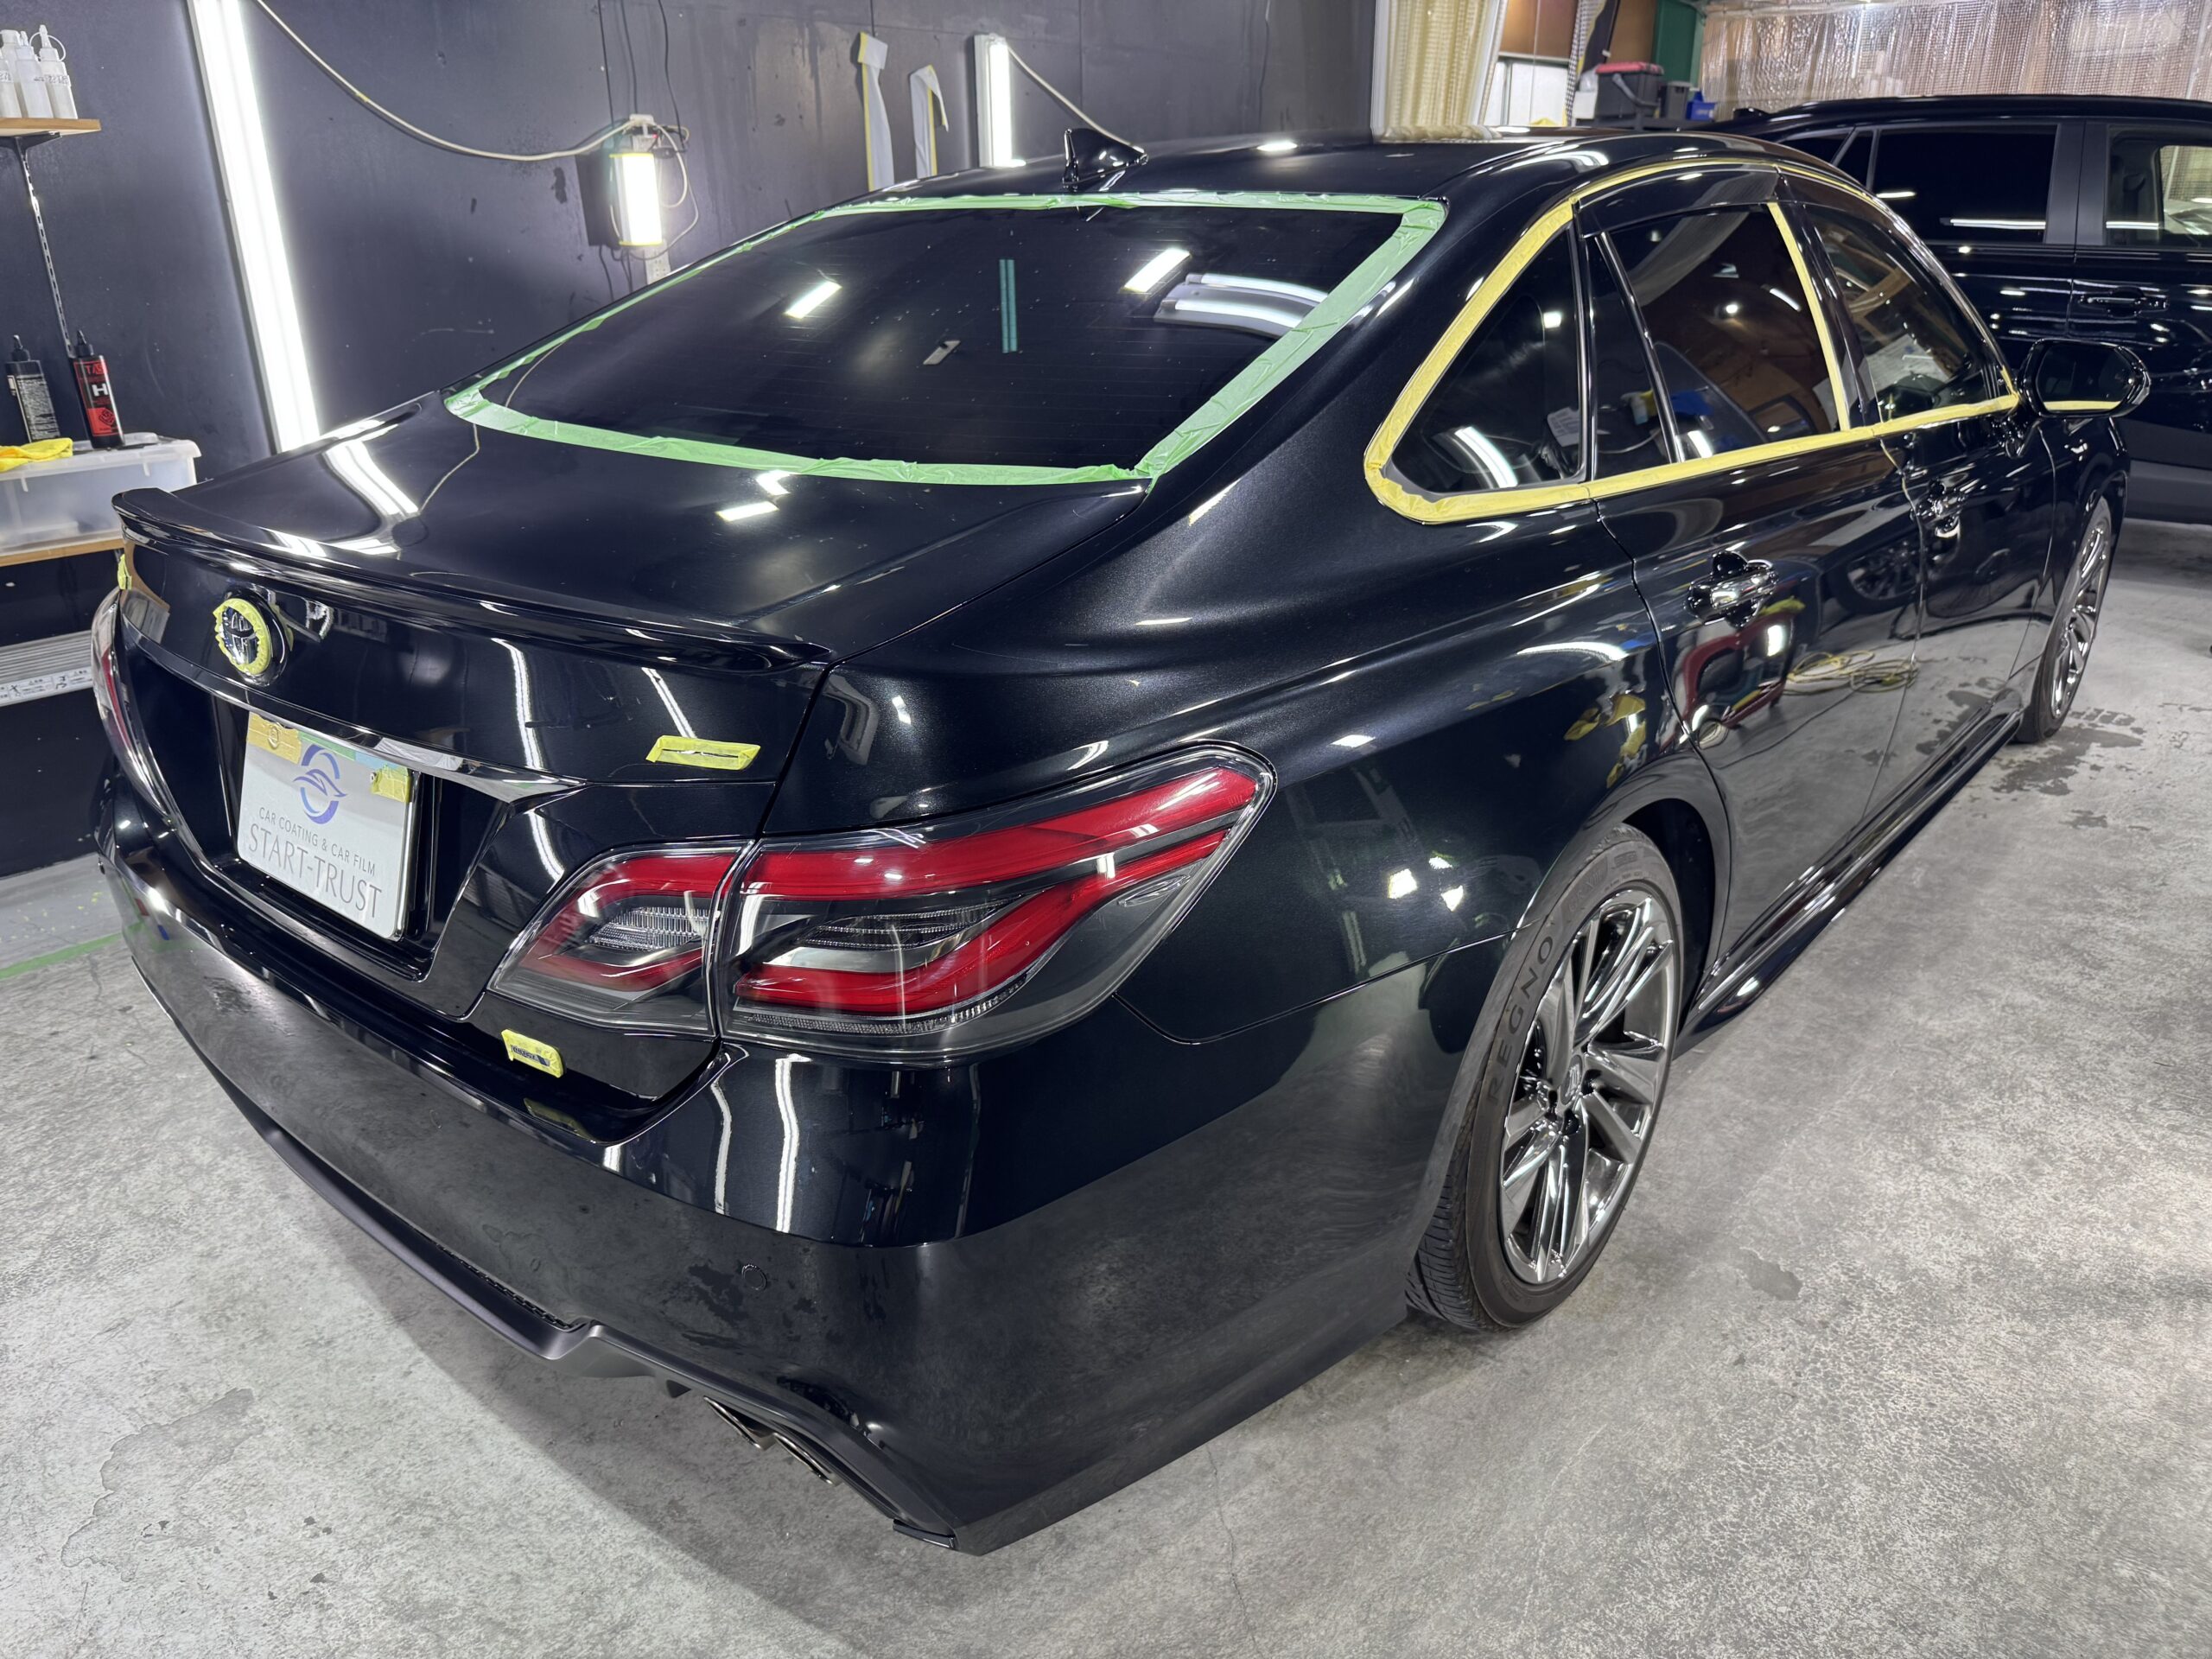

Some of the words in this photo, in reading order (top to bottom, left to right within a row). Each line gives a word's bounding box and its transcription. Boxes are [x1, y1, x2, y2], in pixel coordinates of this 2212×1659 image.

[248, 823, 382, 918] START-TRUST
[259, 807, 276, 824] CAR
[279, 817, 318, 847] COATING
[321, 838, 327, 851] &
[331, 843, 350, 863] CAR
[353, 854, 375, 877] FILM
[1485, 935, 1554, 1103] REGNO
